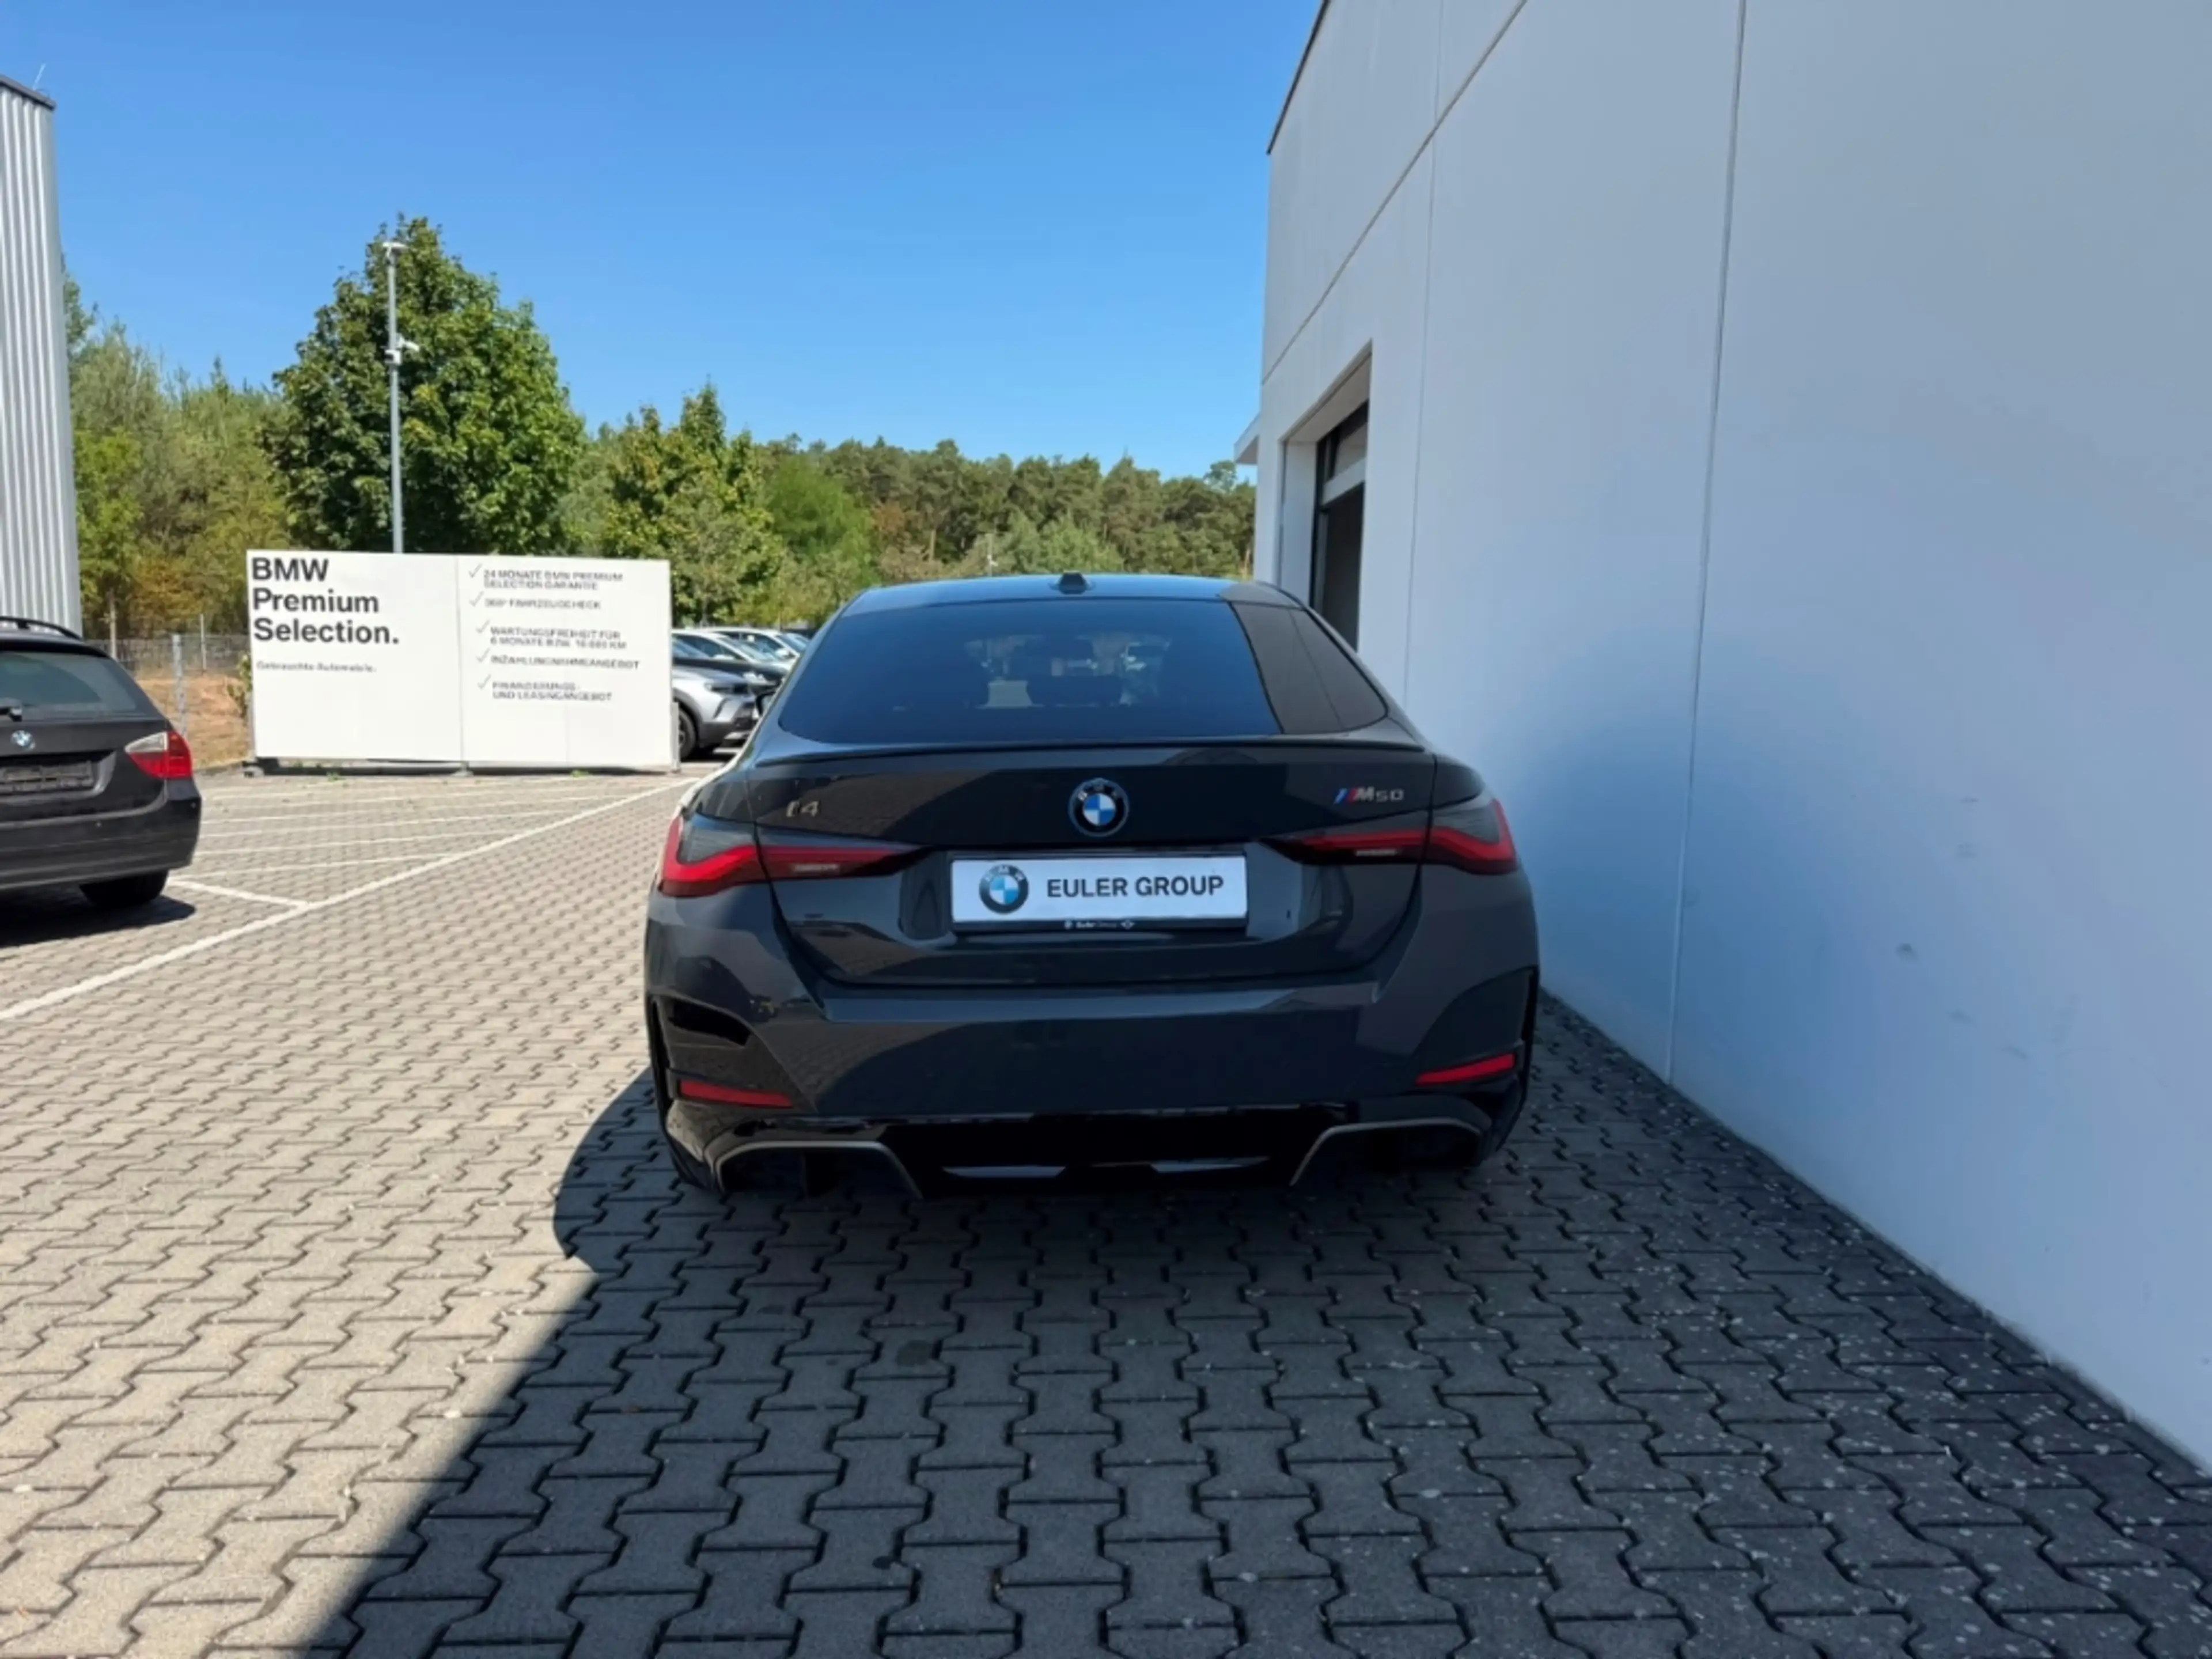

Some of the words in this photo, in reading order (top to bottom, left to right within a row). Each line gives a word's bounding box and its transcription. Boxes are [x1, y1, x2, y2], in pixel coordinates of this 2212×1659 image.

[252, 556, 329, 582] BMW
[498, 570, 542, 579] MONATE
[573, 572, 623, 582] PREMIUM
[484, 579, 543, 589] SELECTION
[252, 587, 379, 613] Premium
[253, 617, 399, 644] Selection.
[499, 637, 543, 646] MONATE
[493, 691, 514, 699] UND
[1047, 877, 1128, 898] EULER
[1134, 874, 1224, 896] GROUP
